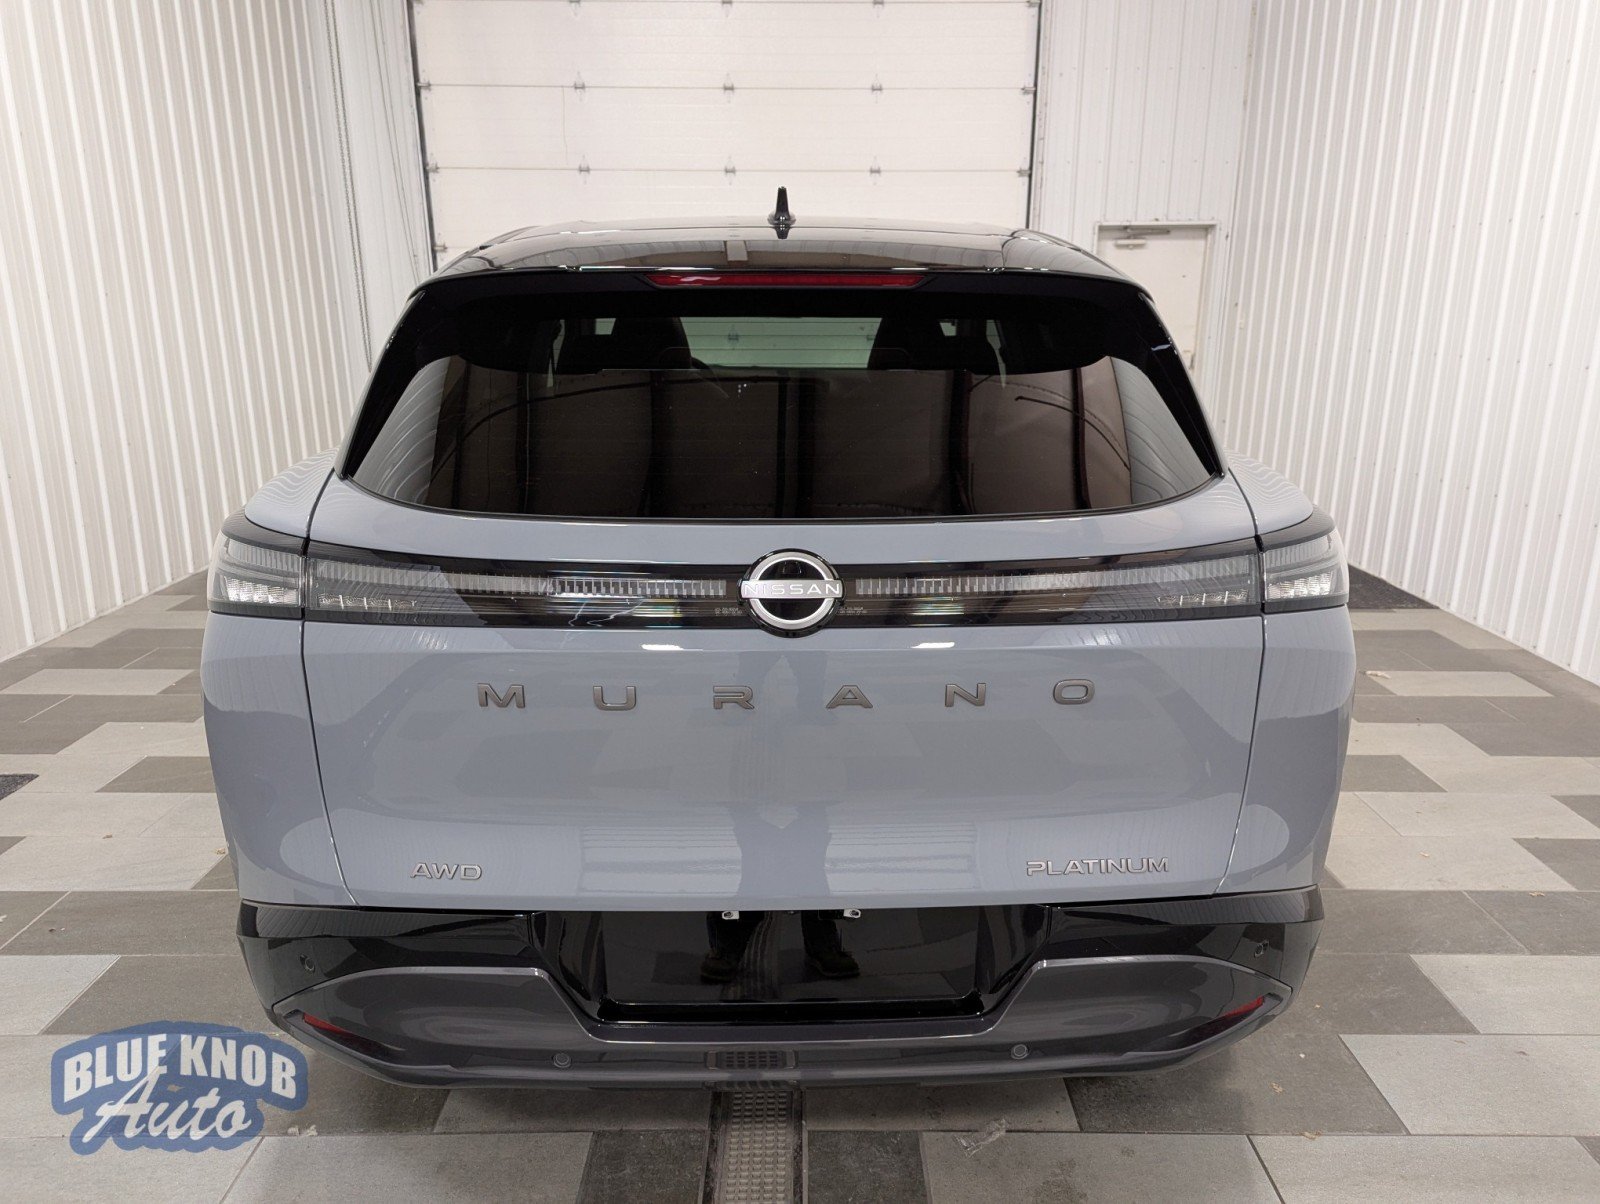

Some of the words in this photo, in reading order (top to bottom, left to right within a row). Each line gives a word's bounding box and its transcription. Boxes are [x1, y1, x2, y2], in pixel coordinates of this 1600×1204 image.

[743, 583, 840, 595] NISSAN
[477, 678, 1096, 711] MURANO
[410, 862, 483, 880] AWD
[1026, 857, 1169, 876] PLATINUM
